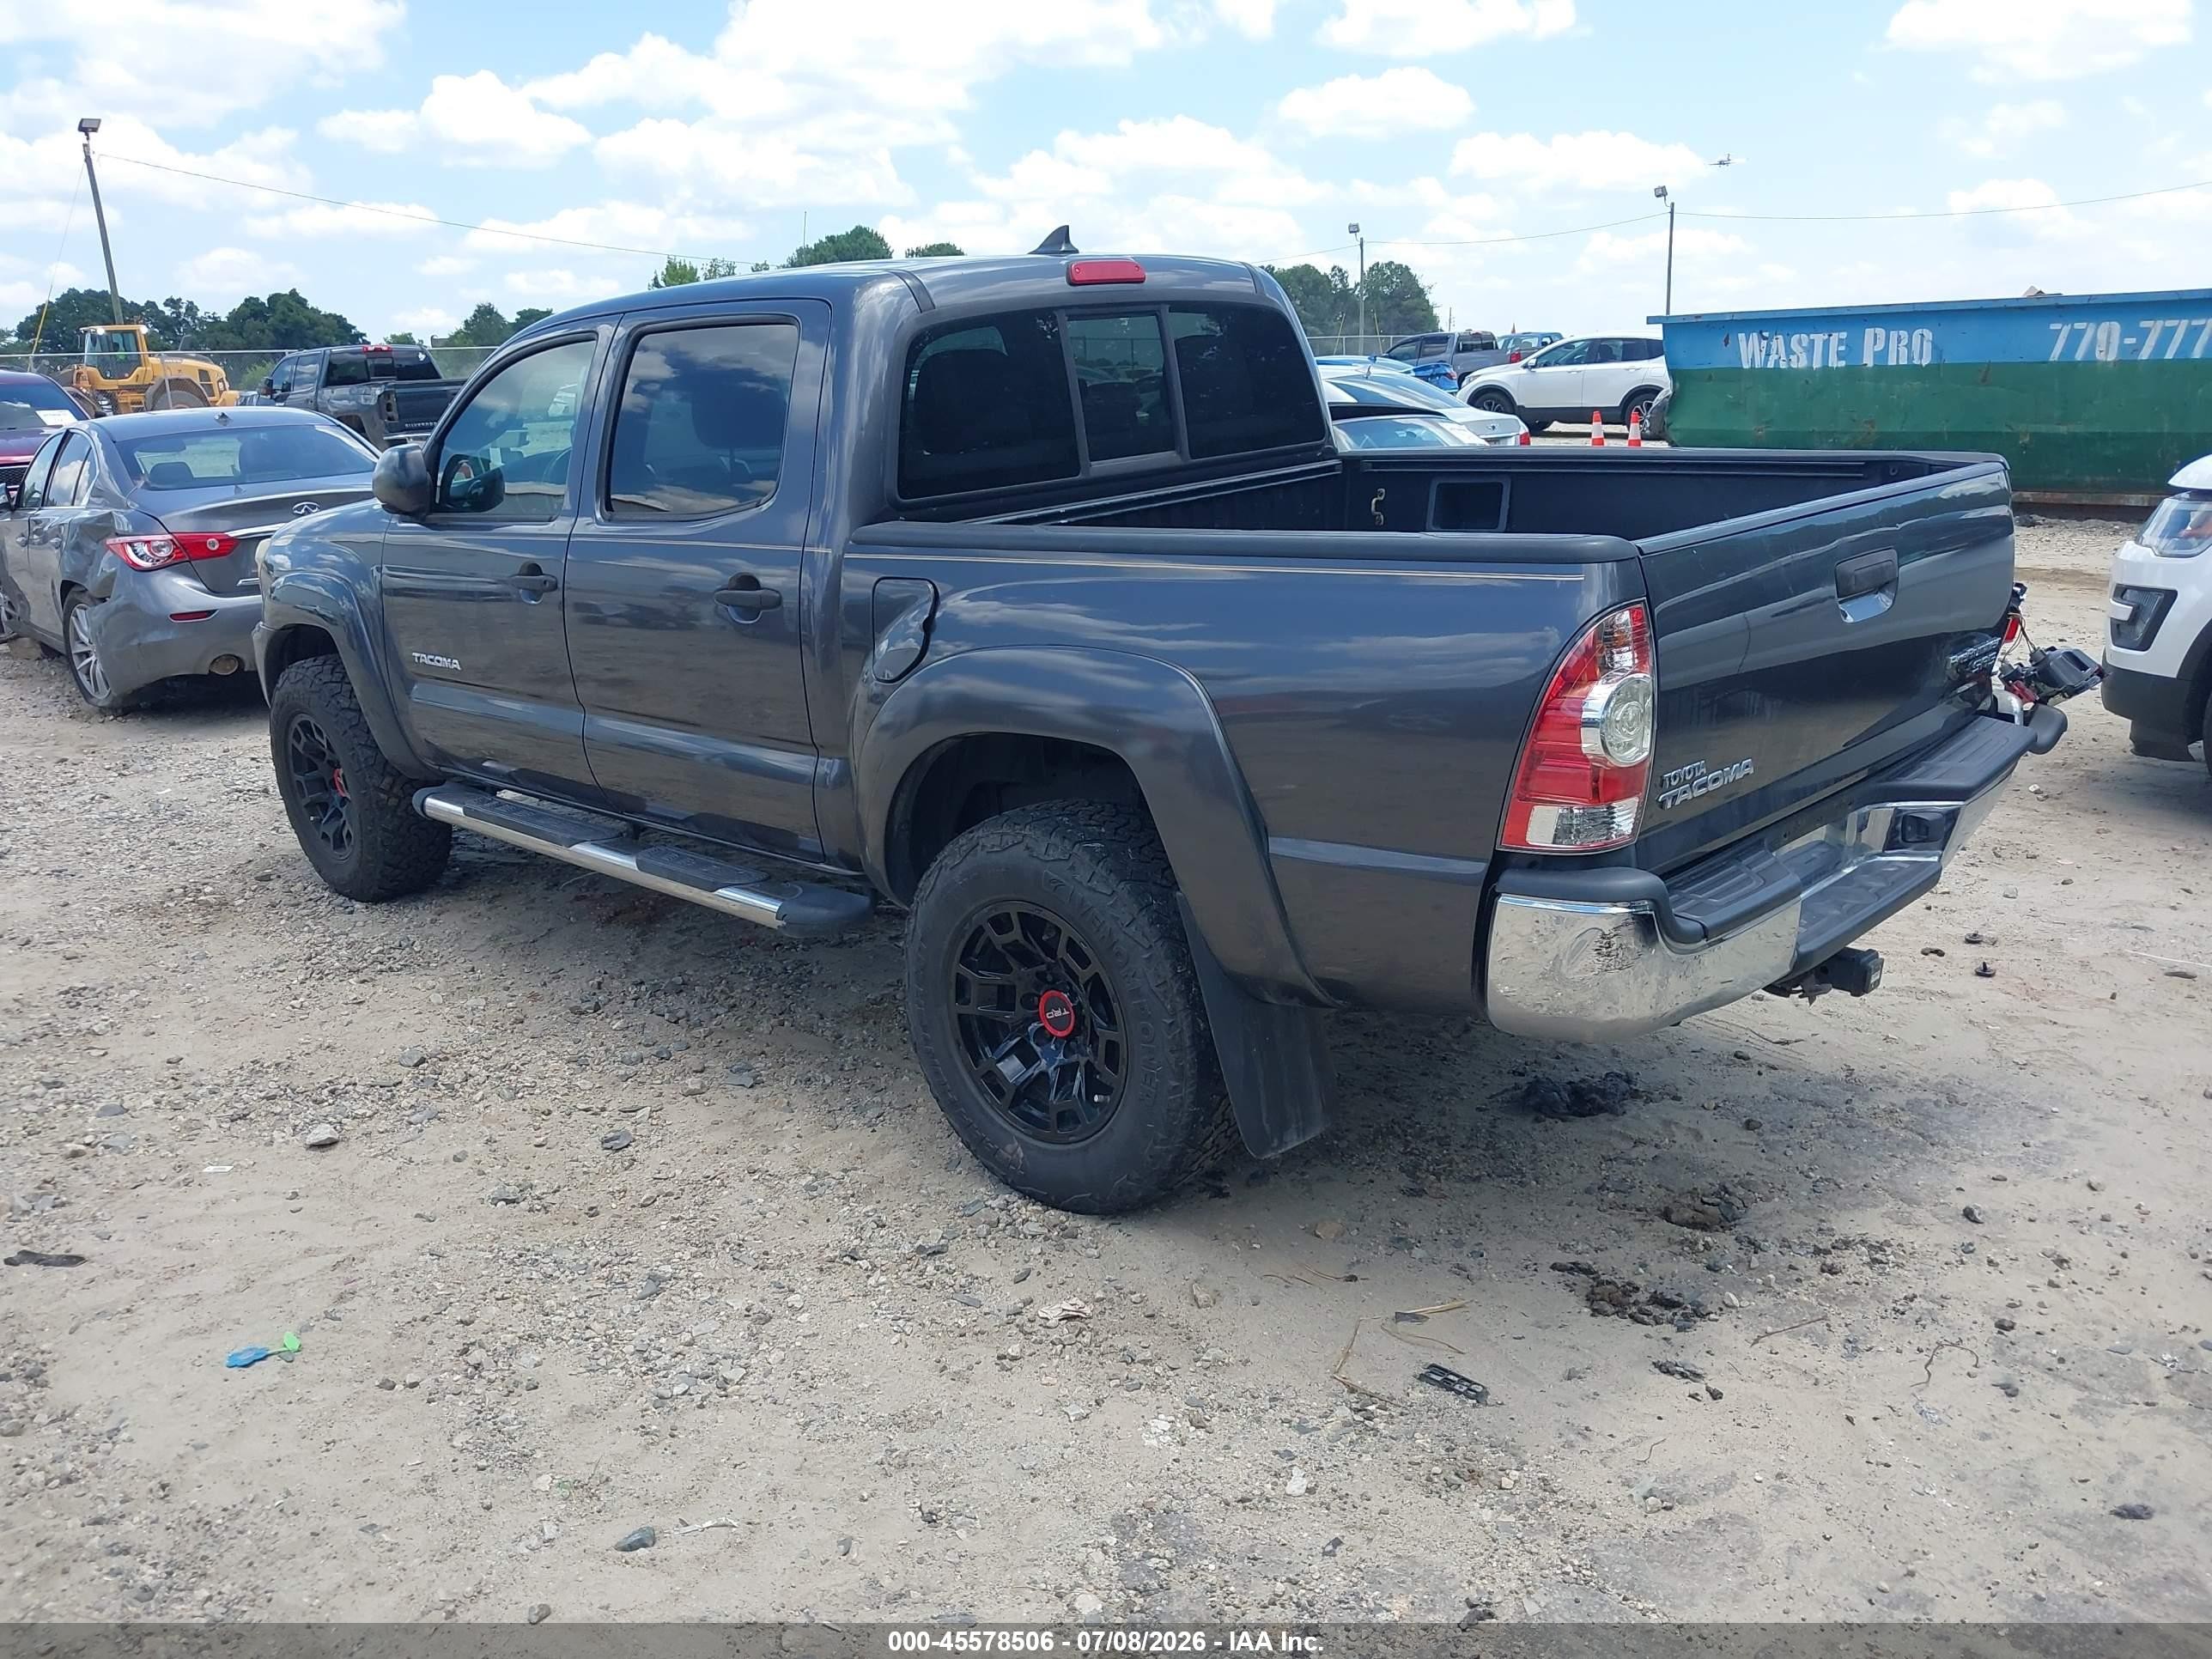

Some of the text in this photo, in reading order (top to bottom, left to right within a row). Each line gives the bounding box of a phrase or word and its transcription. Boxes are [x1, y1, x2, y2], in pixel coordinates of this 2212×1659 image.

[1737, 327, 1933, 369] WASTE PRO
[412, 652, 462, 671] TACOMA
[1657, 758, 1754, 809] TACOMA
[1662, 760, 1706, 788] TOYOTA
[1046, 1007, 1070, 1019] TRD
